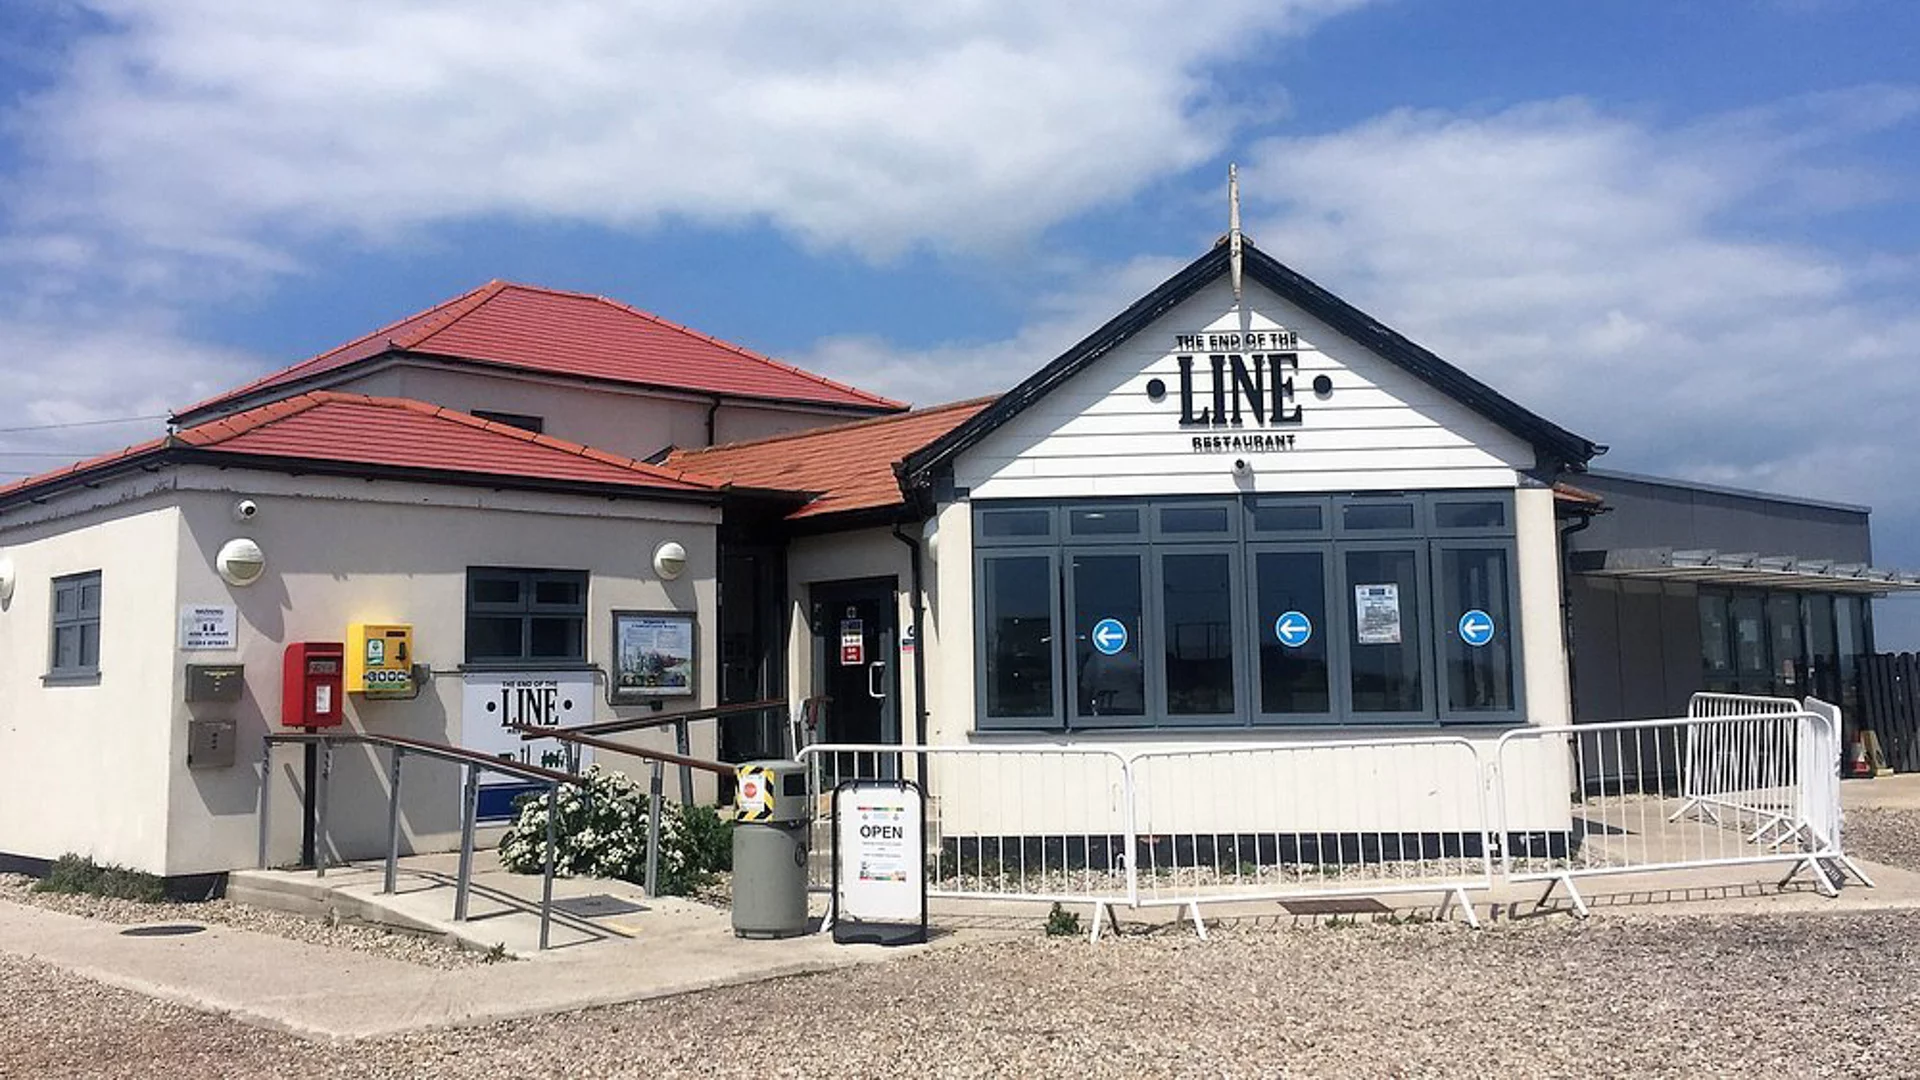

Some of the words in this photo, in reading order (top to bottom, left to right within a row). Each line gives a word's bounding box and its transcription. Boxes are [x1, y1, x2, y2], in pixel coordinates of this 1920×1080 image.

[1176, 335, 1204, 347] THE
[1209, 334, 1240, 346] END
[1246, 333, 1266, 345] OF
[1269, 332, 1298, 345] THE
[1177, 353, 1303, 425] LINE
[1192, 435, 1296, 449] RESTAURANT
[501, 688, 559, 727] LINE
[860, 824, 903, 839] OPEN
